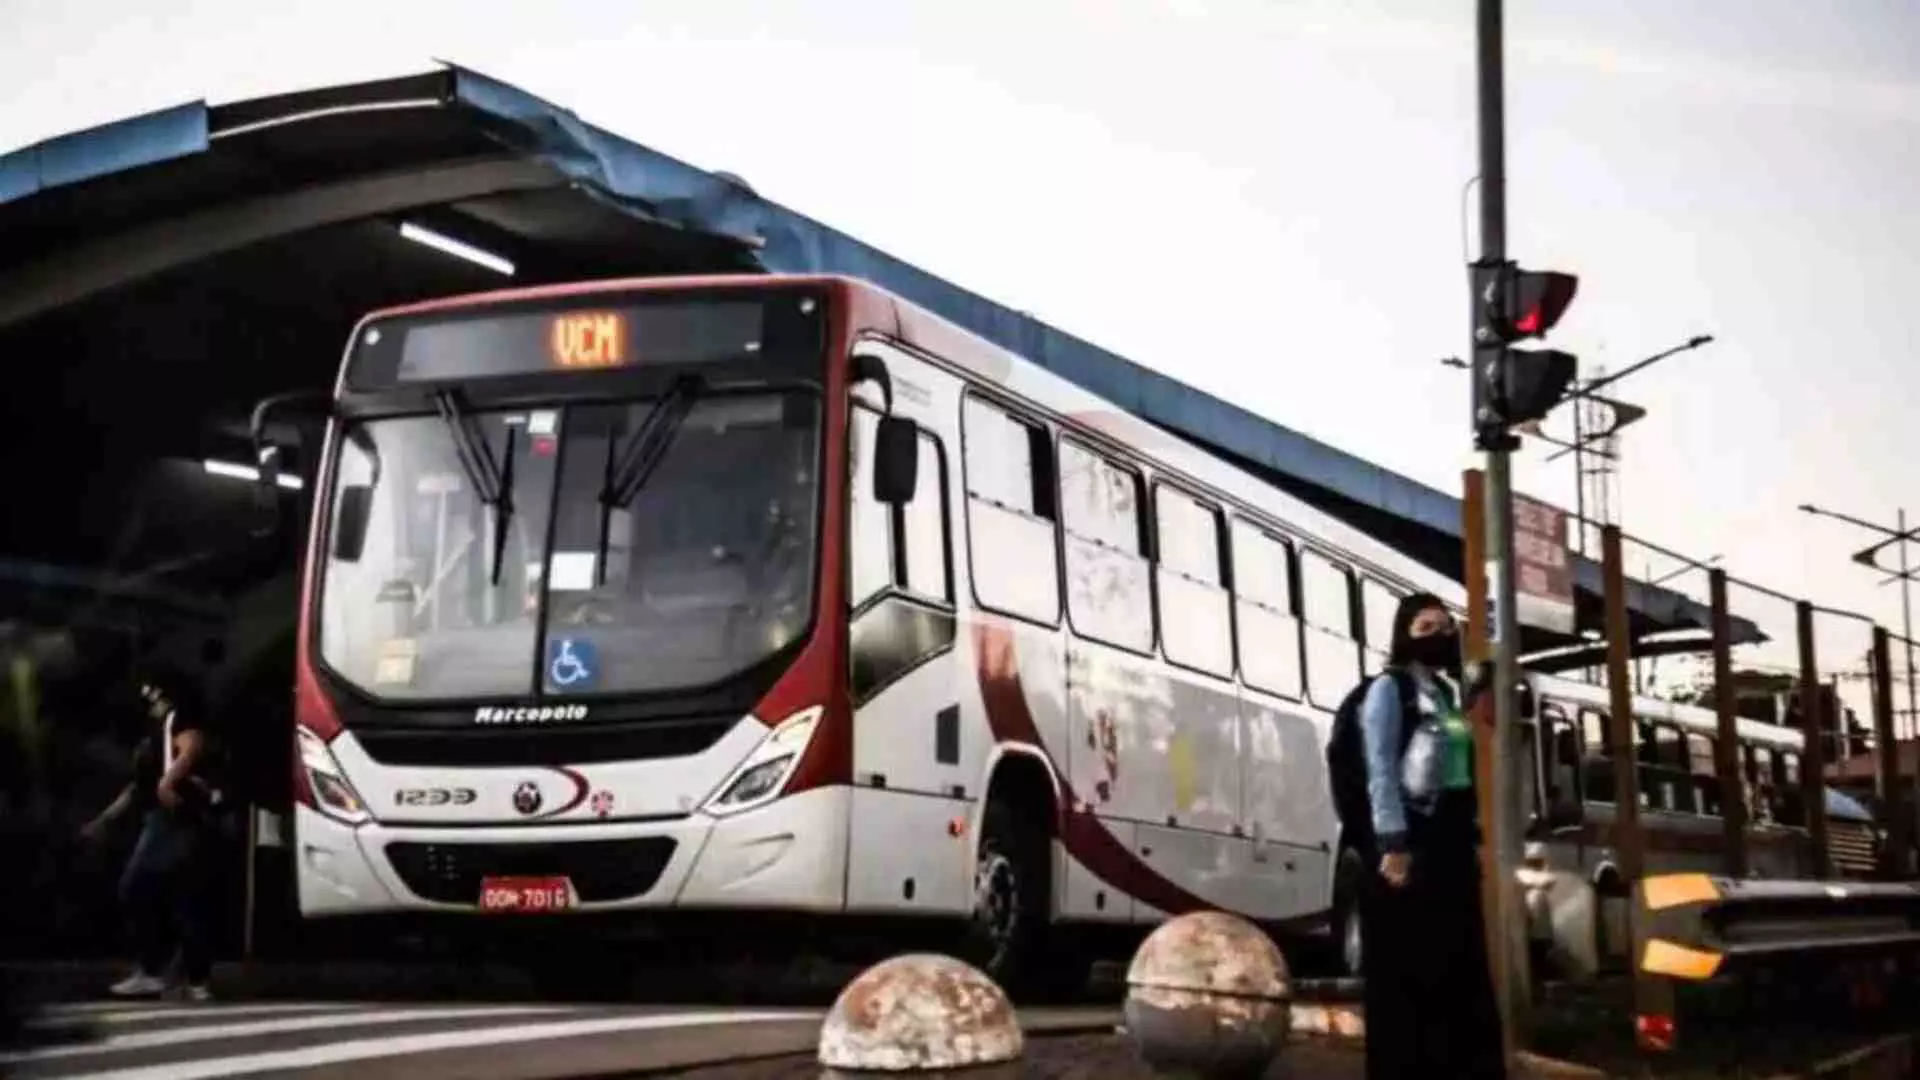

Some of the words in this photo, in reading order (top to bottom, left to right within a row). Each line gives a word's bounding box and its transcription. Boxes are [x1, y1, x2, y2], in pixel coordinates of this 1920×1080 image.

[555, 312, 620, 364] VCM
[475, 704, 588, 724] Marcopolo
[395, 787, 478, 806] 1233
